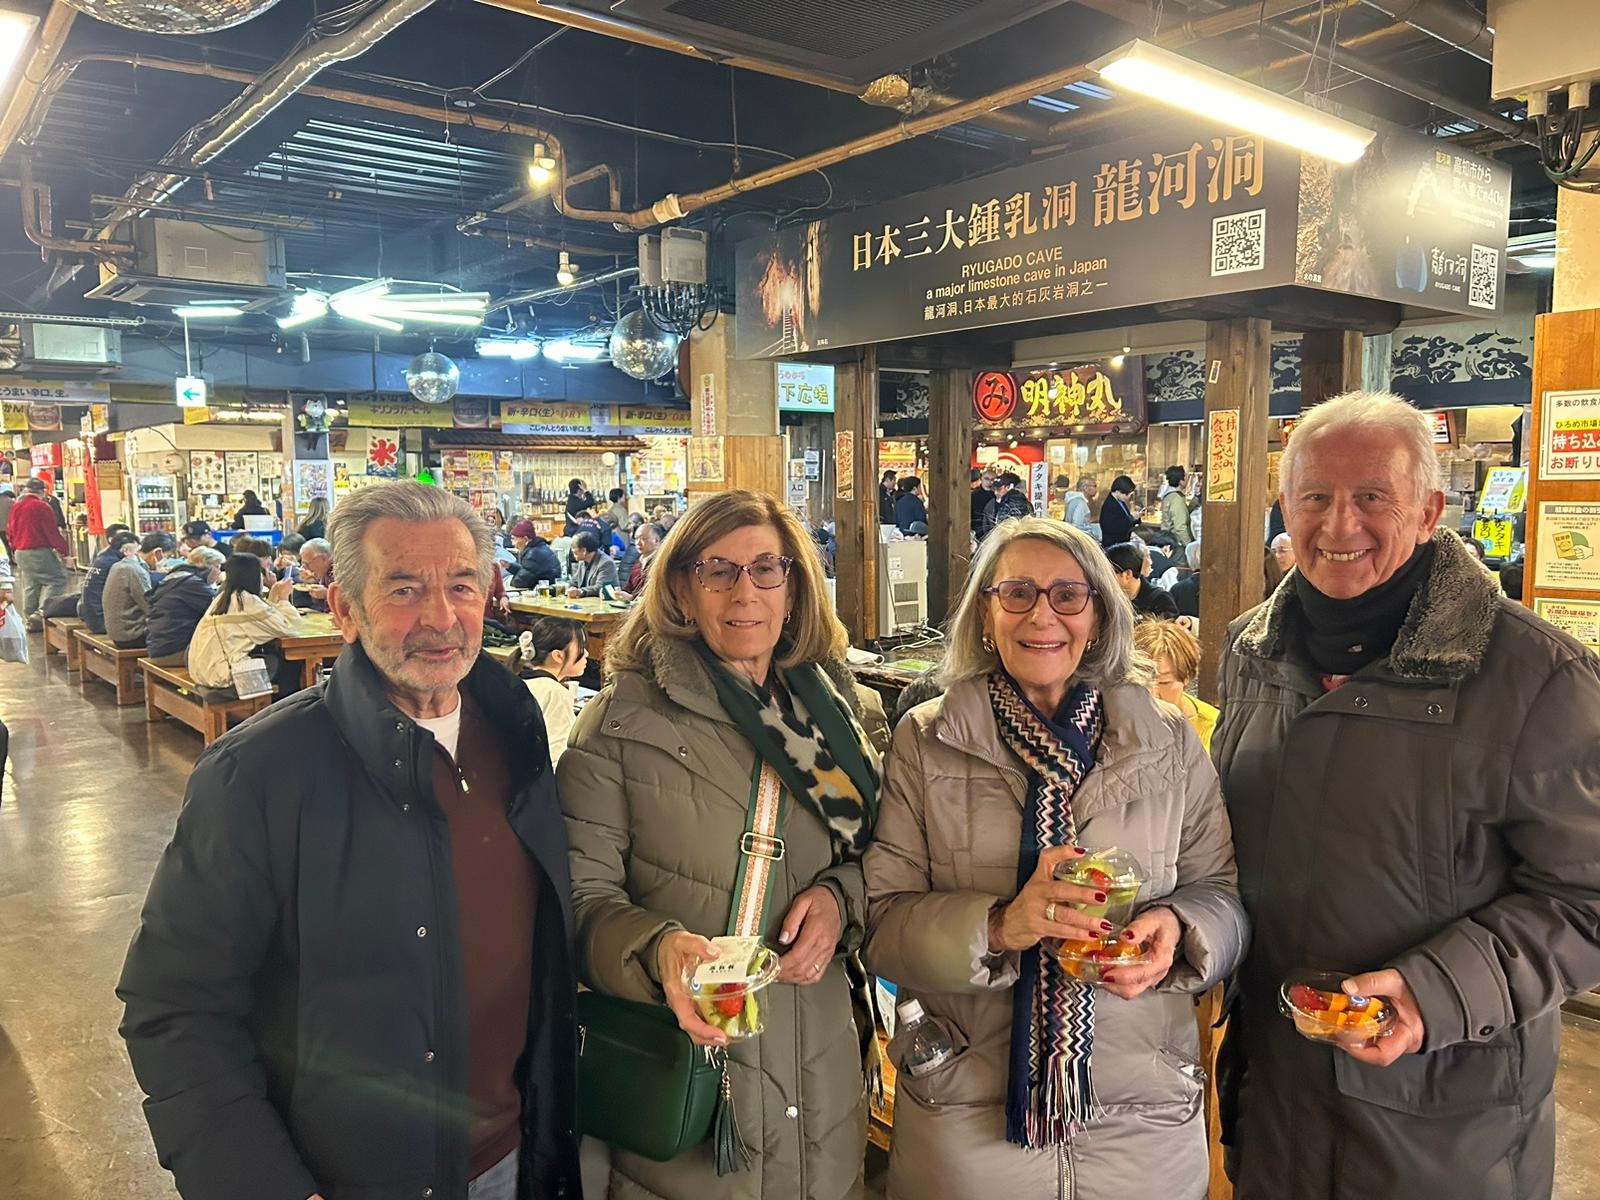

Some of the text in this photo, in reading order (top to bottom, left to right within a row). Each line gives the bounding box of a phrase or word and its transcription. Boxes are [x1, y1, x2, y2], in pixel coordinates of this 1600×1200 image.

[853, 134, 1264, 271] 日本三大鍾乳洞 龍河洞
[961, 246, 1063, 278] RYUGADO CAVE
[926, 258, 1108, 300] a major limestone cave in Japan
[778, 383, 829, 404] 下広場
[1021, 371, 1122, 416] 明神丸
[1555, 398, 1600, 408] 多数の飲食
[1555, 419, 1600, 429] ひろめ市場
[369, 438, 397, 467] 氷
[1552, 432, 1600, 450] 持ち込
